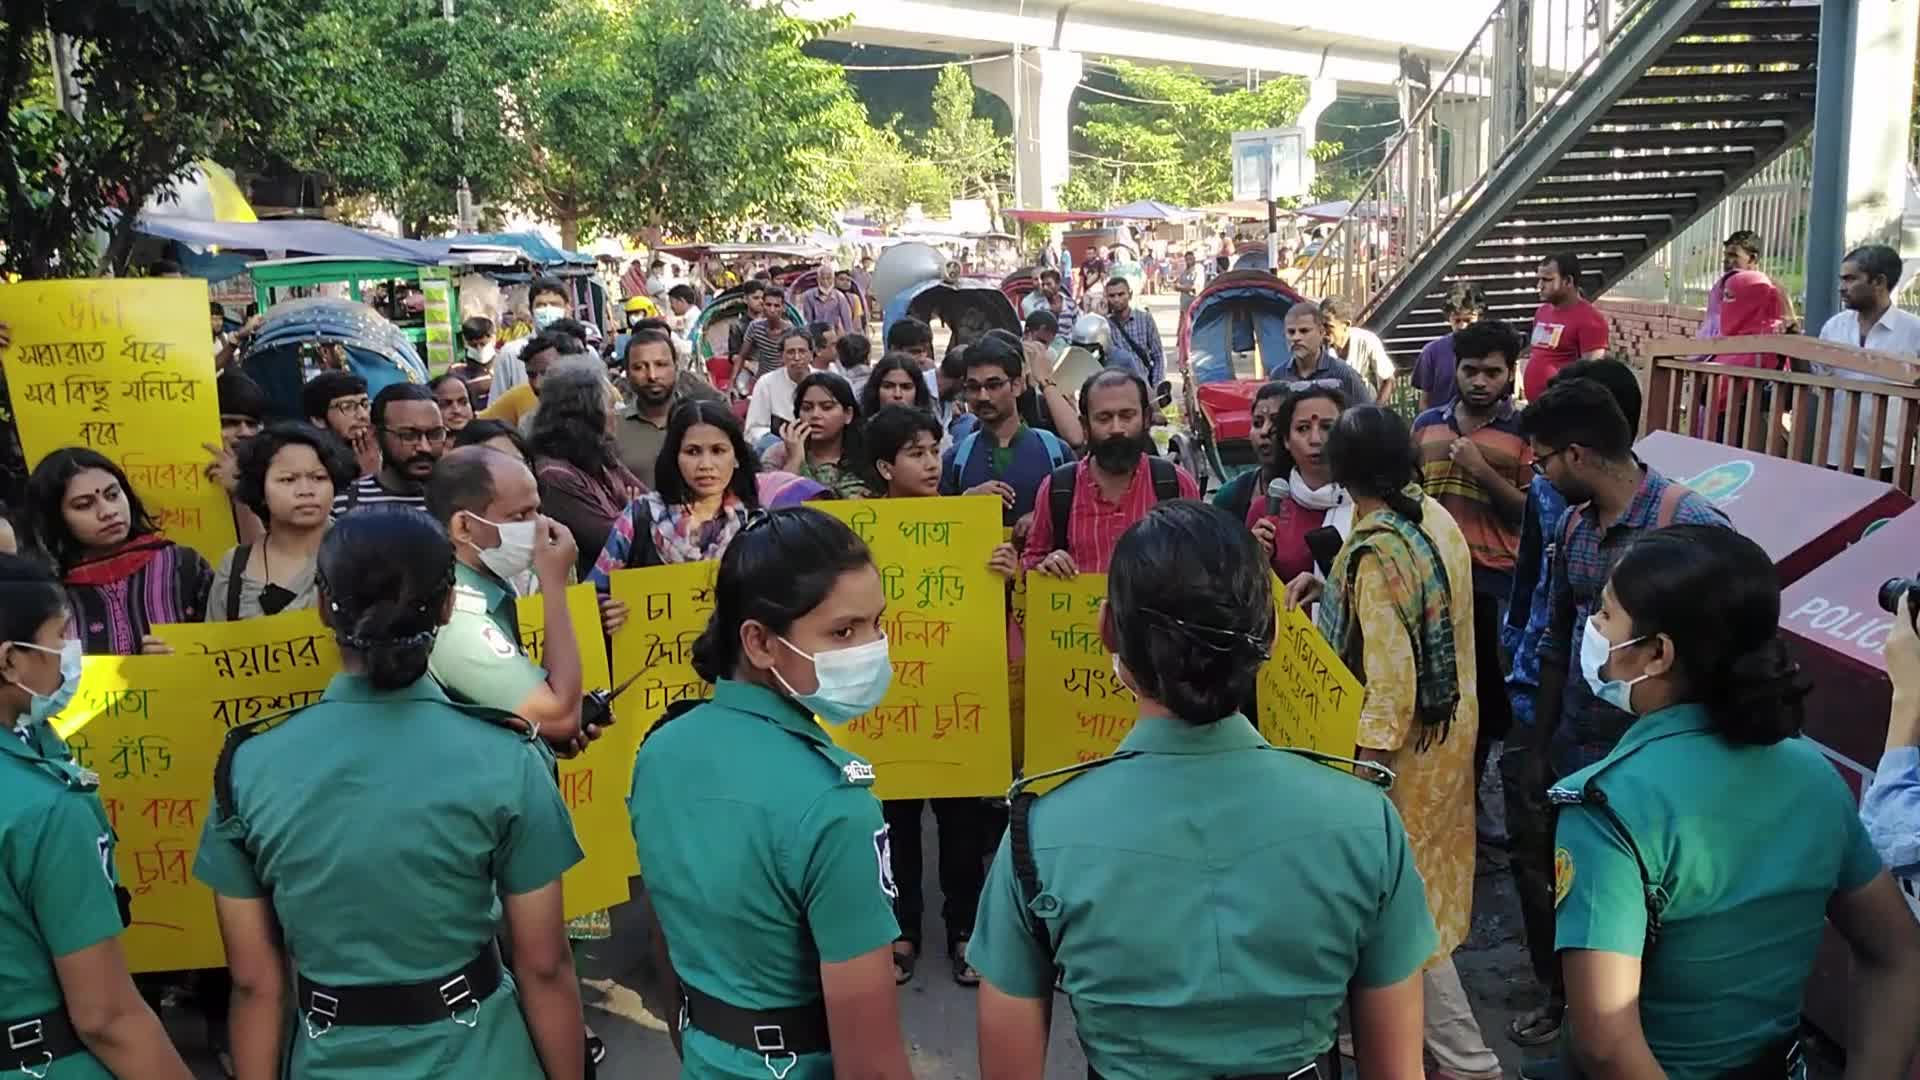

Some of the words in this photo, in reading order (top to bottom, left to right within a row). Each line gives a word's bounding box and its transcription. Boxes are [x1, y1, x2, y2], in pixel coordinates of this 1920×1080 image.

[120, 334, 177, 366] ধরে
[24, 381, 57, 406] সব
[60, 374, 112, 413] কিছু
[121, 371, 202, 403] মনিটর
[79, 420, 125, 448] করে
[120, 452, 205, 491] লিকের
[898, 520, 964, 547] পাতা
[645, 591, 672, 621] চা
[916, 564, 966, 609] কুঁড়ি
[1785, 597, 1896, 655] POLIC
[1063, 667, 1127, 700] সংহ
[930, 691, 990, 740] চুরি
[109, 736, 173, 780] কুঁড়ি
[141, 798, 201, 828] করে
[133, 838, 192, 895] চুরি
